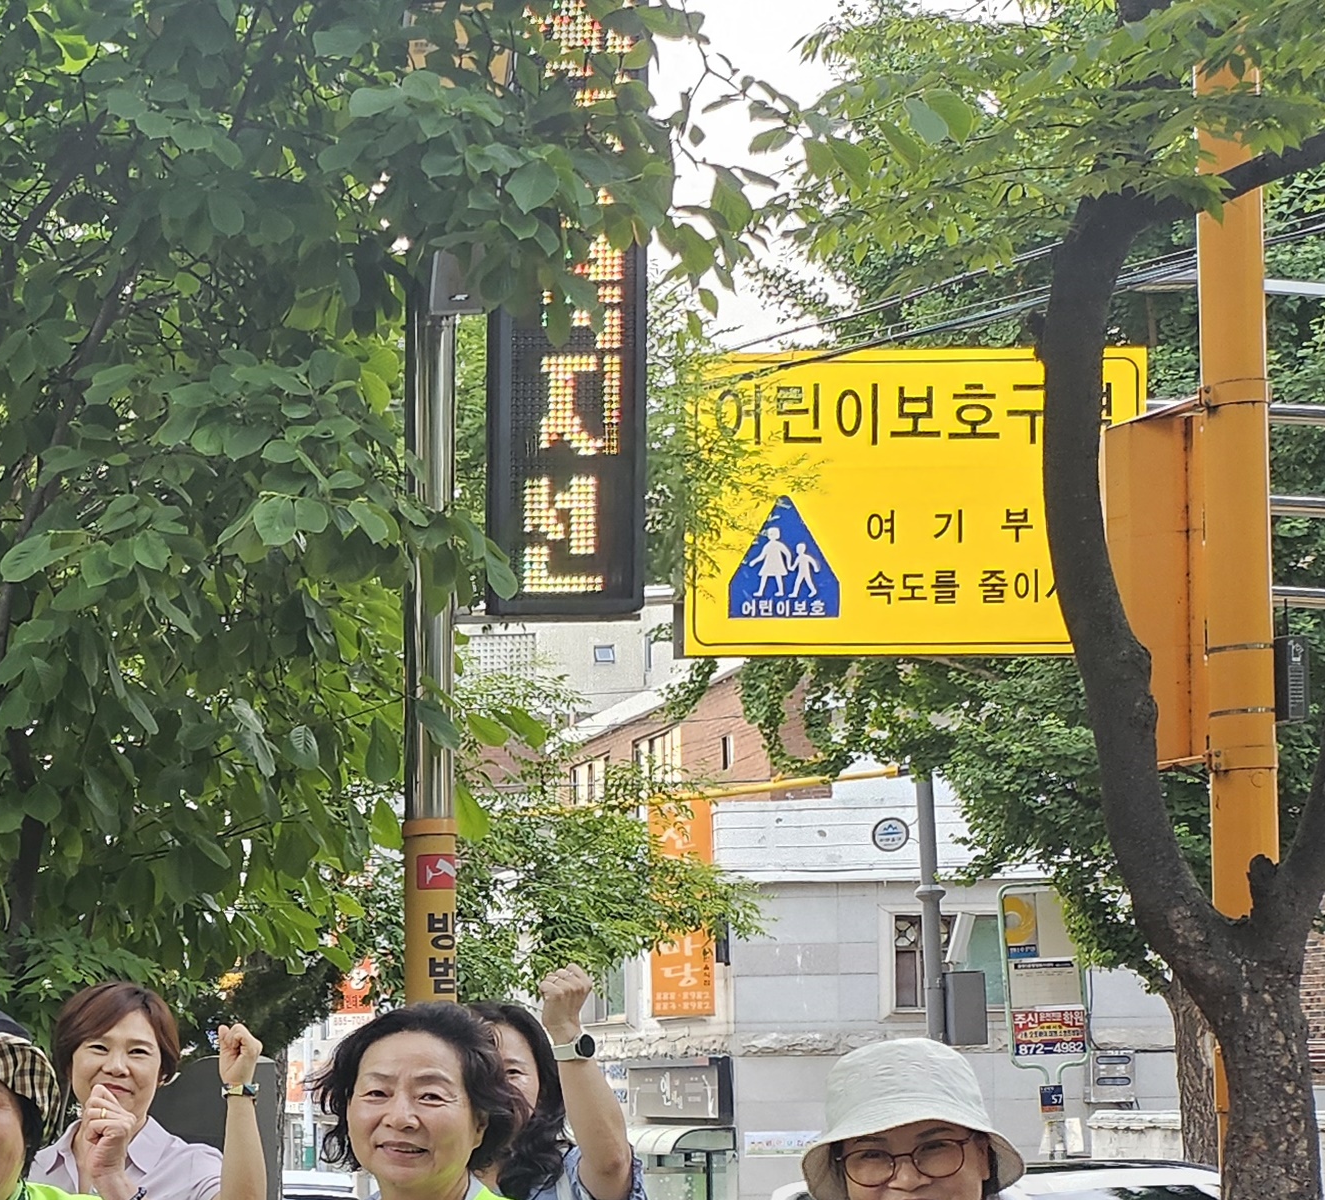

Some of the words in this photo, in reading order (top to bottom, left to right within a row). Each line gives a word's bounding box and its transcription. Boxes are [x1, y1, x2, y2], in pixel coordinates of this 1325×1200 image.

[717, 382, 1113, 446] 어린이보호구
[866, 568, 960, 605] 속도를
[741, 600, 826, 618] 어린이보호
